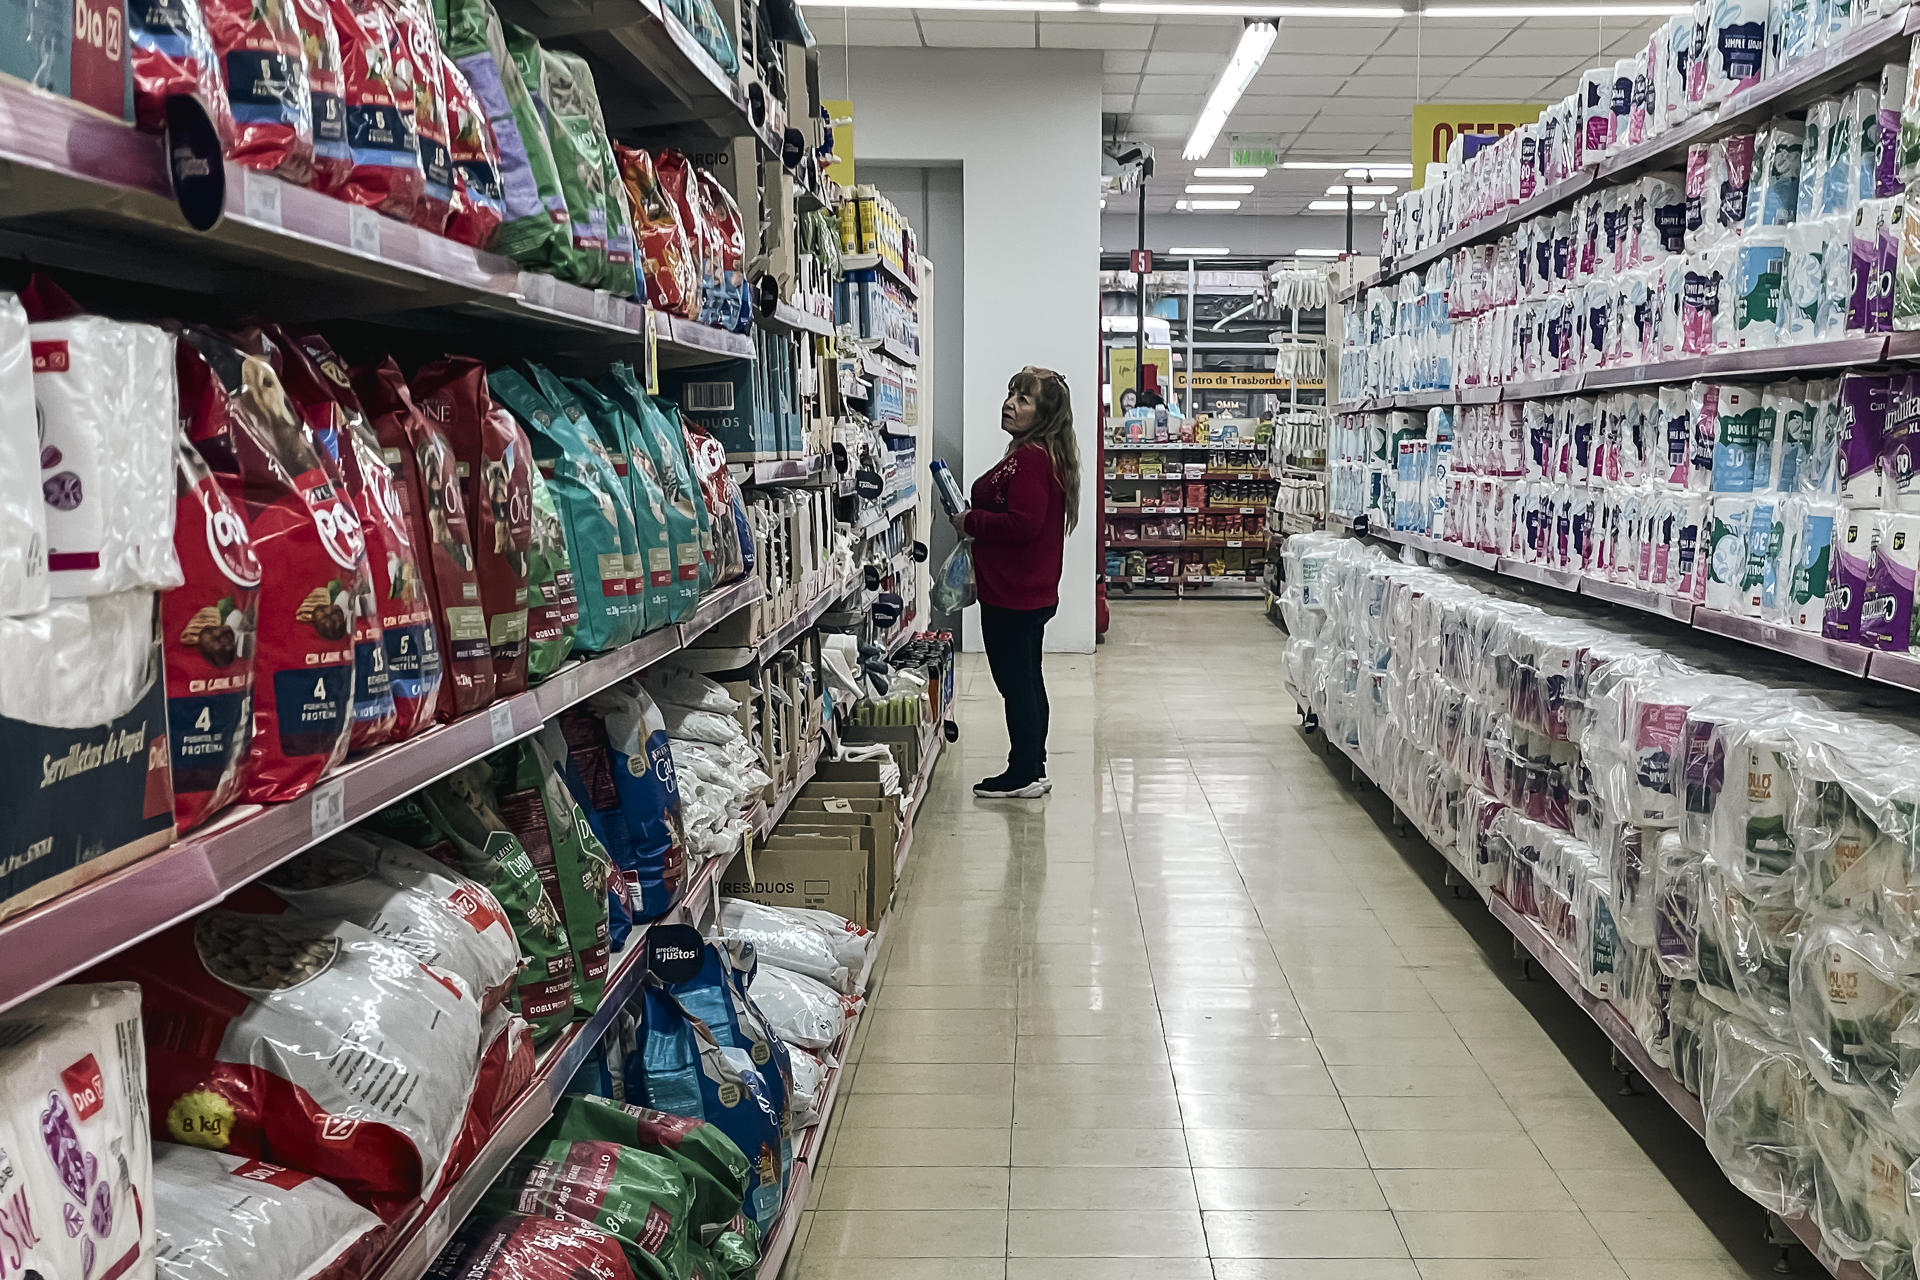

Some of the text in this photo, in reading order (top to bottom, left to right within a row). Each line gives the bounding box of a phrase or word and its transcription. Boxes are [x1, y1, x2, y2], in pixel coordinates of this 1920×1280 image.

[1138, 252, 1145, 272] 5
[1178, 375, 1212, 385] Cntro
[1232, 376, 1282, 385] Trasbordo
[1907, 422, 1920, 435] XL
[1725, 448, 1744, 467] 30
[313, 677, 326, 700] 4
[195, 706, 211, 732] 4
[723, 882, 795, 895] RESIDUOS
[656, 945, 696, 963] precios justos
[182, 1116, 222, 1136] 8 kg
[605, 1216, 620, 1233] 8
